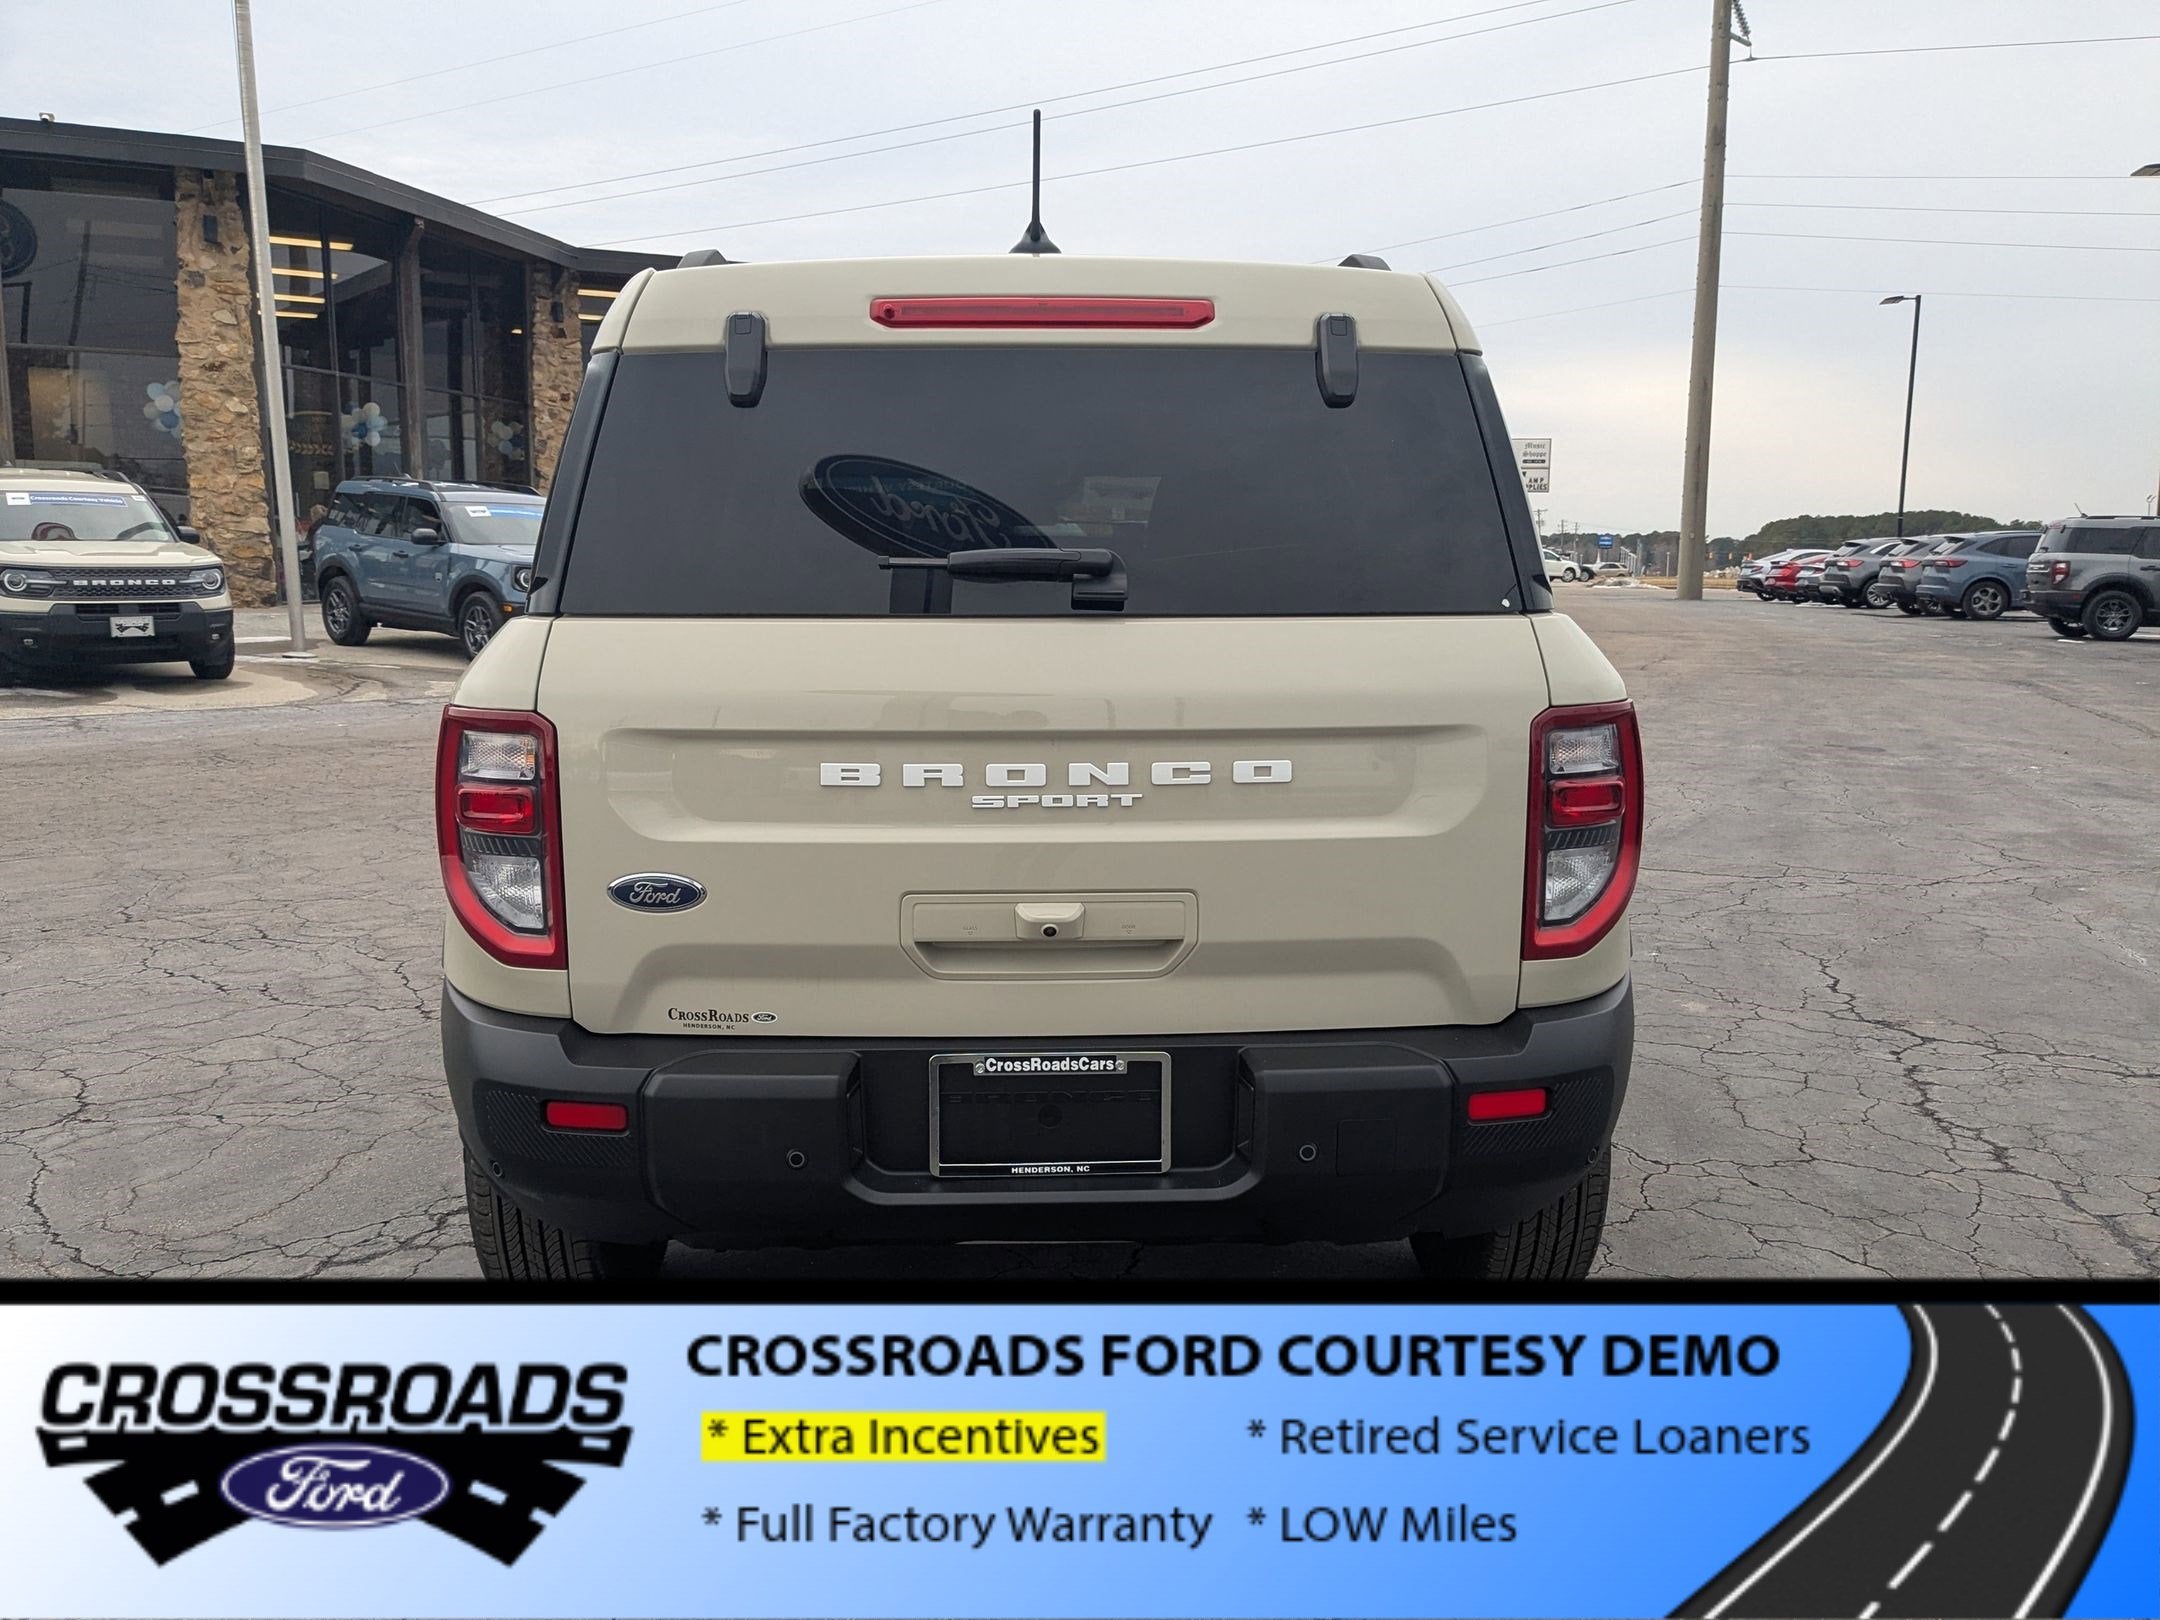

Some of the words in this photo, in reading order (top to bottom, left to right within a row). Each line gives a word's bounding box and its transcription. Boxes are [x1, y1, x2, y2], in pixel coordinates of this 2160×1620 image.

[820, 760, 1293, 787] BRONCO
[972, 794, 1143, 808] SPORT
[629, 881, 681, 904] Ford
[985, 1057, 1114, 1072] CrossRoadsCars
[1011, 1166, 1074, 1174] HENDERSON,
[1077, 1165, 1090, 1173] NC
